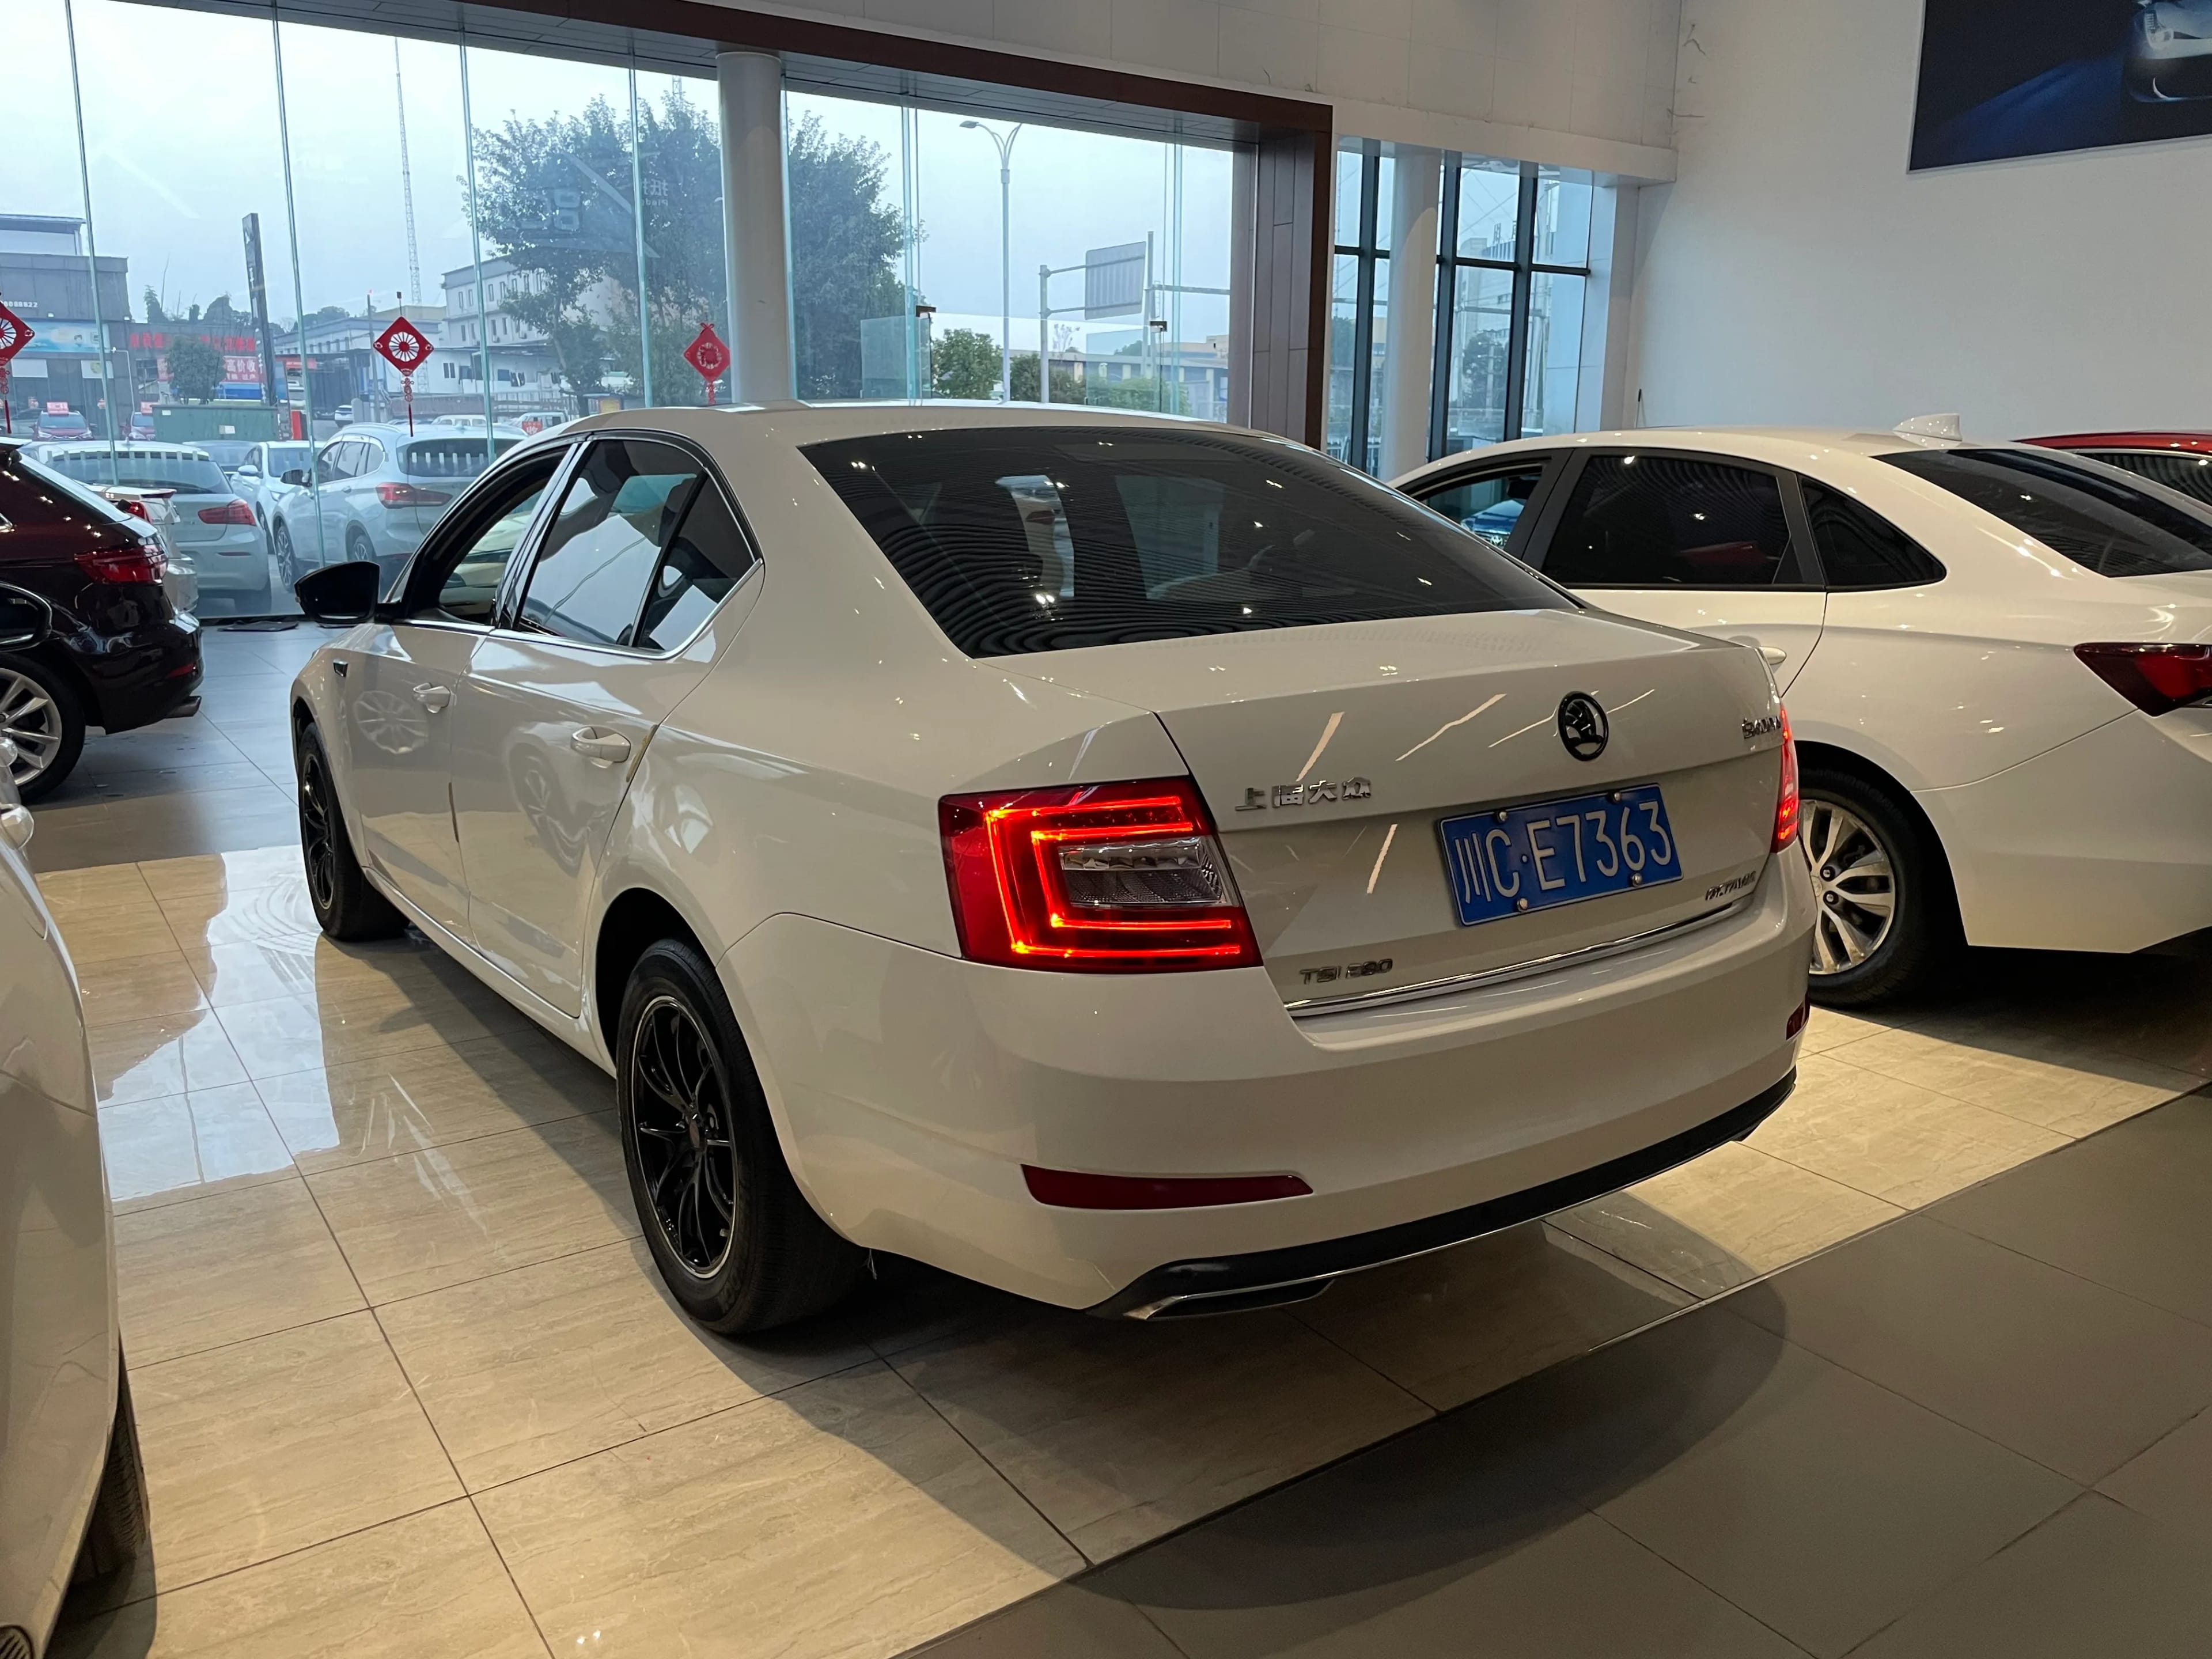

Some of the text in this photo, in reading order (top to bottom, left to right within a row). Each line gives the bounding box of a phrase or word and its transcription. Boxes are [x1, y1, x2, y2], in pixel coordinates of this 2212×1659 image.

[1234, 775, 1372, 812] 上海大众
[1299, 965, 1343, 985] TSI
